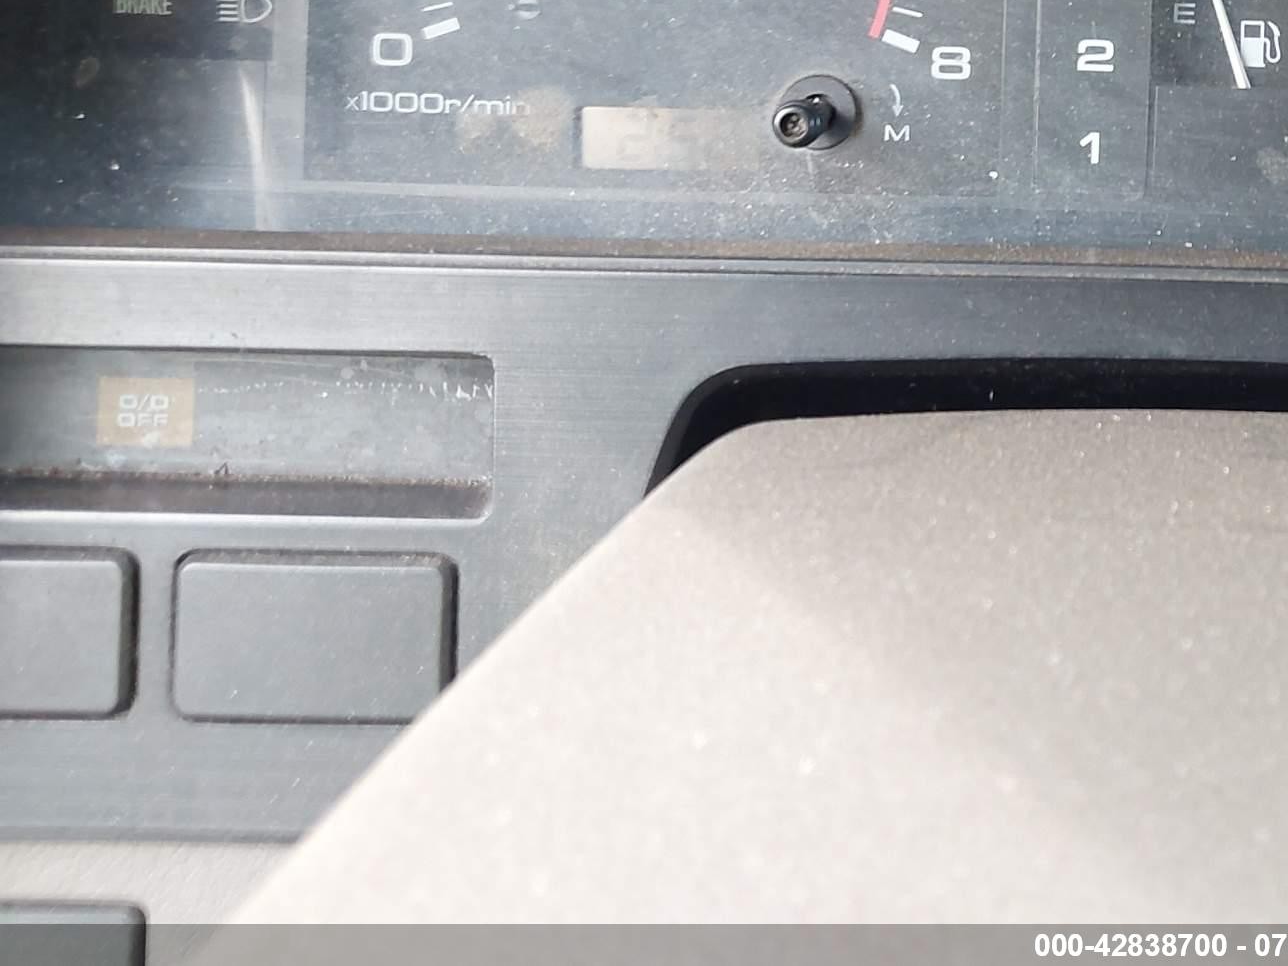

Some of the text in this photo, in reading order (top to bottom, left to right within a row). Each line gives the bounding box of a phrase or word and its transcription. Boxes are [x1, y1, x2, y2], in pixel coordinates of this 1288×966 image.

[1173, 2, 1197, 24] E
[370, 32, 413, 66] 0
[931, 46, 972, 80] 8
[1076, 39, 1115, 73] 2
[883, 125, 911, 143] M
[1079, 131, 1100, 164] 1
[117, 412, 169, 427] OFF
